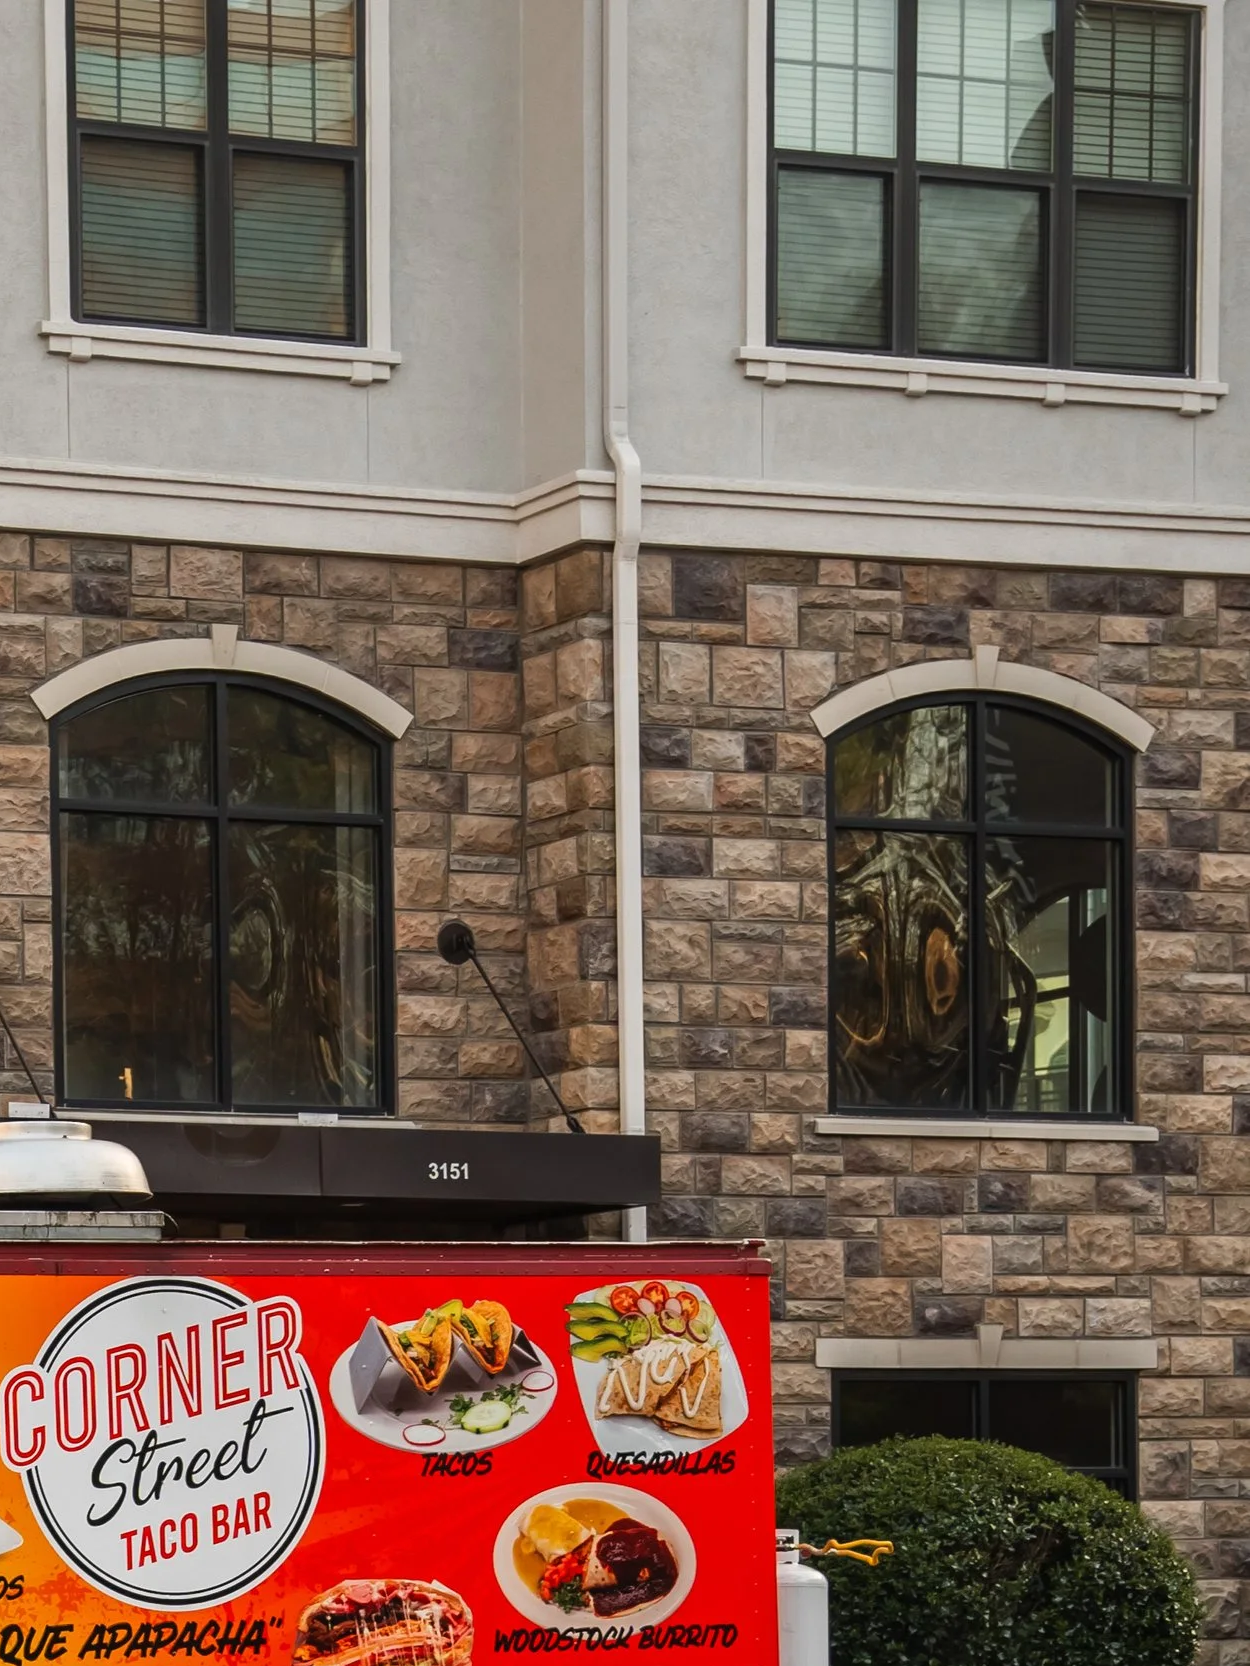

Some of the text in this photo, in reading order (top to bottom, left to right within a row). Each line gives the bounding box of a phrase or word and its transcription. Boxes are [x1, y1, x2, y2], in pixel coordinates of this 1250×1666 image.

[428, 1162, 470, 1180] 3151
[4, 1301, 301, 1467] CORNER
[86, 1398, 295, 1527] Street
[420, 1451, 493, 1478] TACOS
[586, 1450, 737, 1480] QUESADILLAS
[119, 1491, 272, 1571] TACO BAR
[493, 1623, 739, 1653] WOODSTOCK BURRITO
